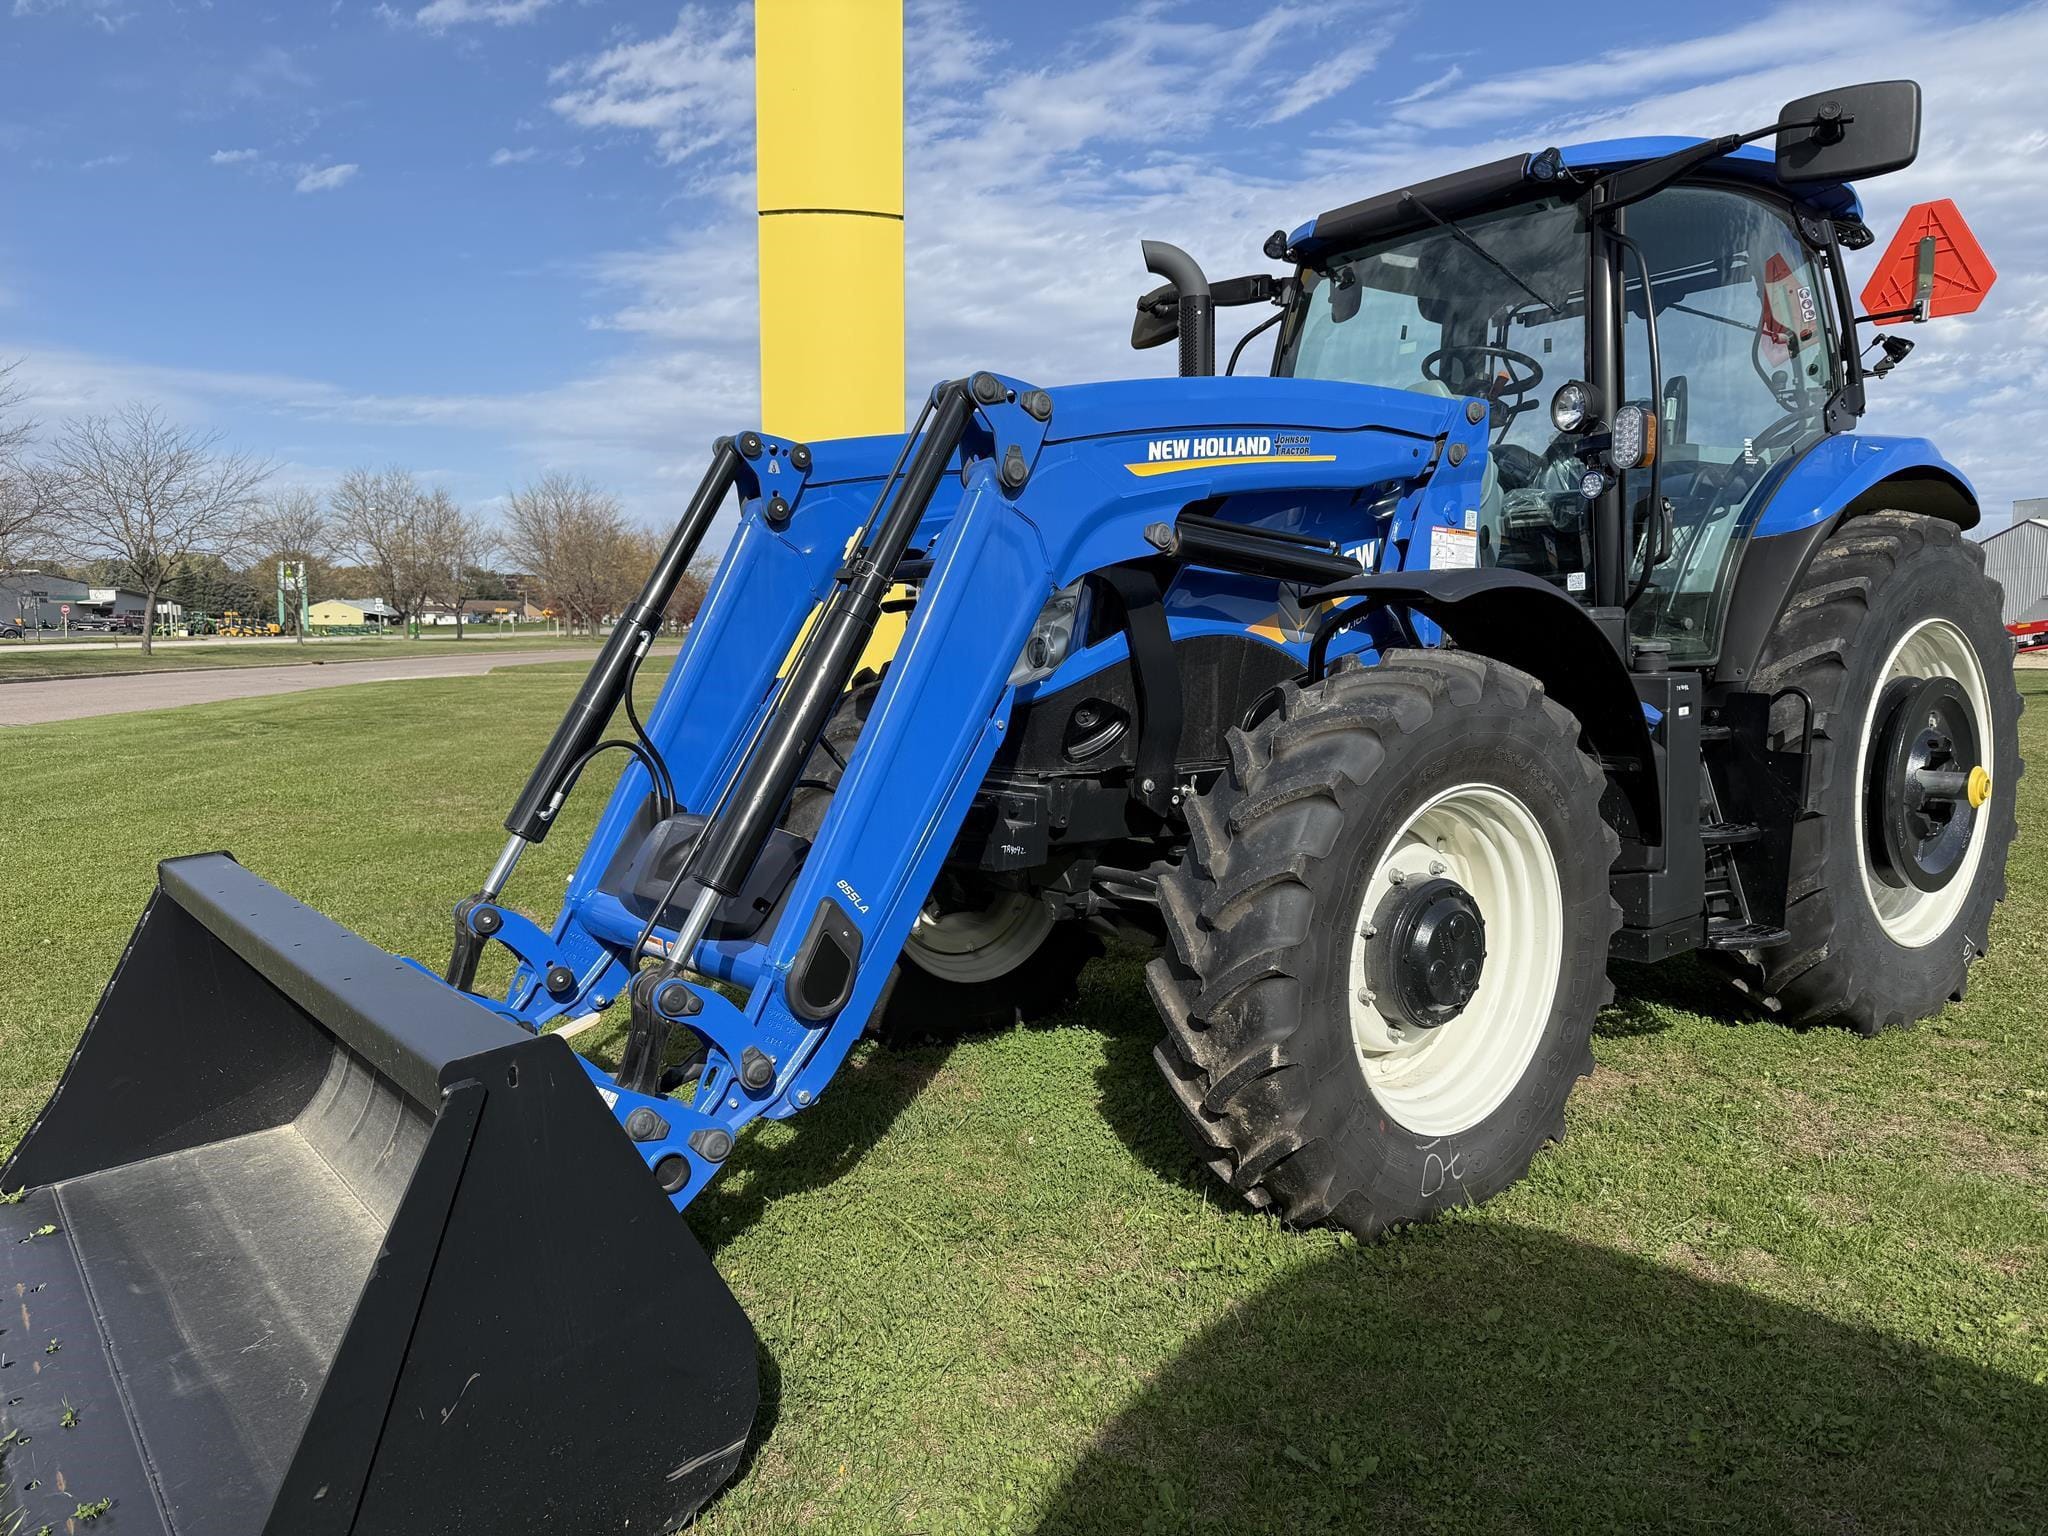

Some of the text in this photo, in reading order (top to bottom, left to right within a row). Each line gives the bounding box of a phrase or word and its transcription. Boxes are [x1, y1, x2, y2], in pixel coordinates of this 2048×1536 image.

[1274, 433, 1310, 445] JOHNSON
[1148, 436, 1271, 461] NEW HOLLAND
[1275, 444, 1310, 456] TRACTOR
[836, 879, 870, 914] 855LA
